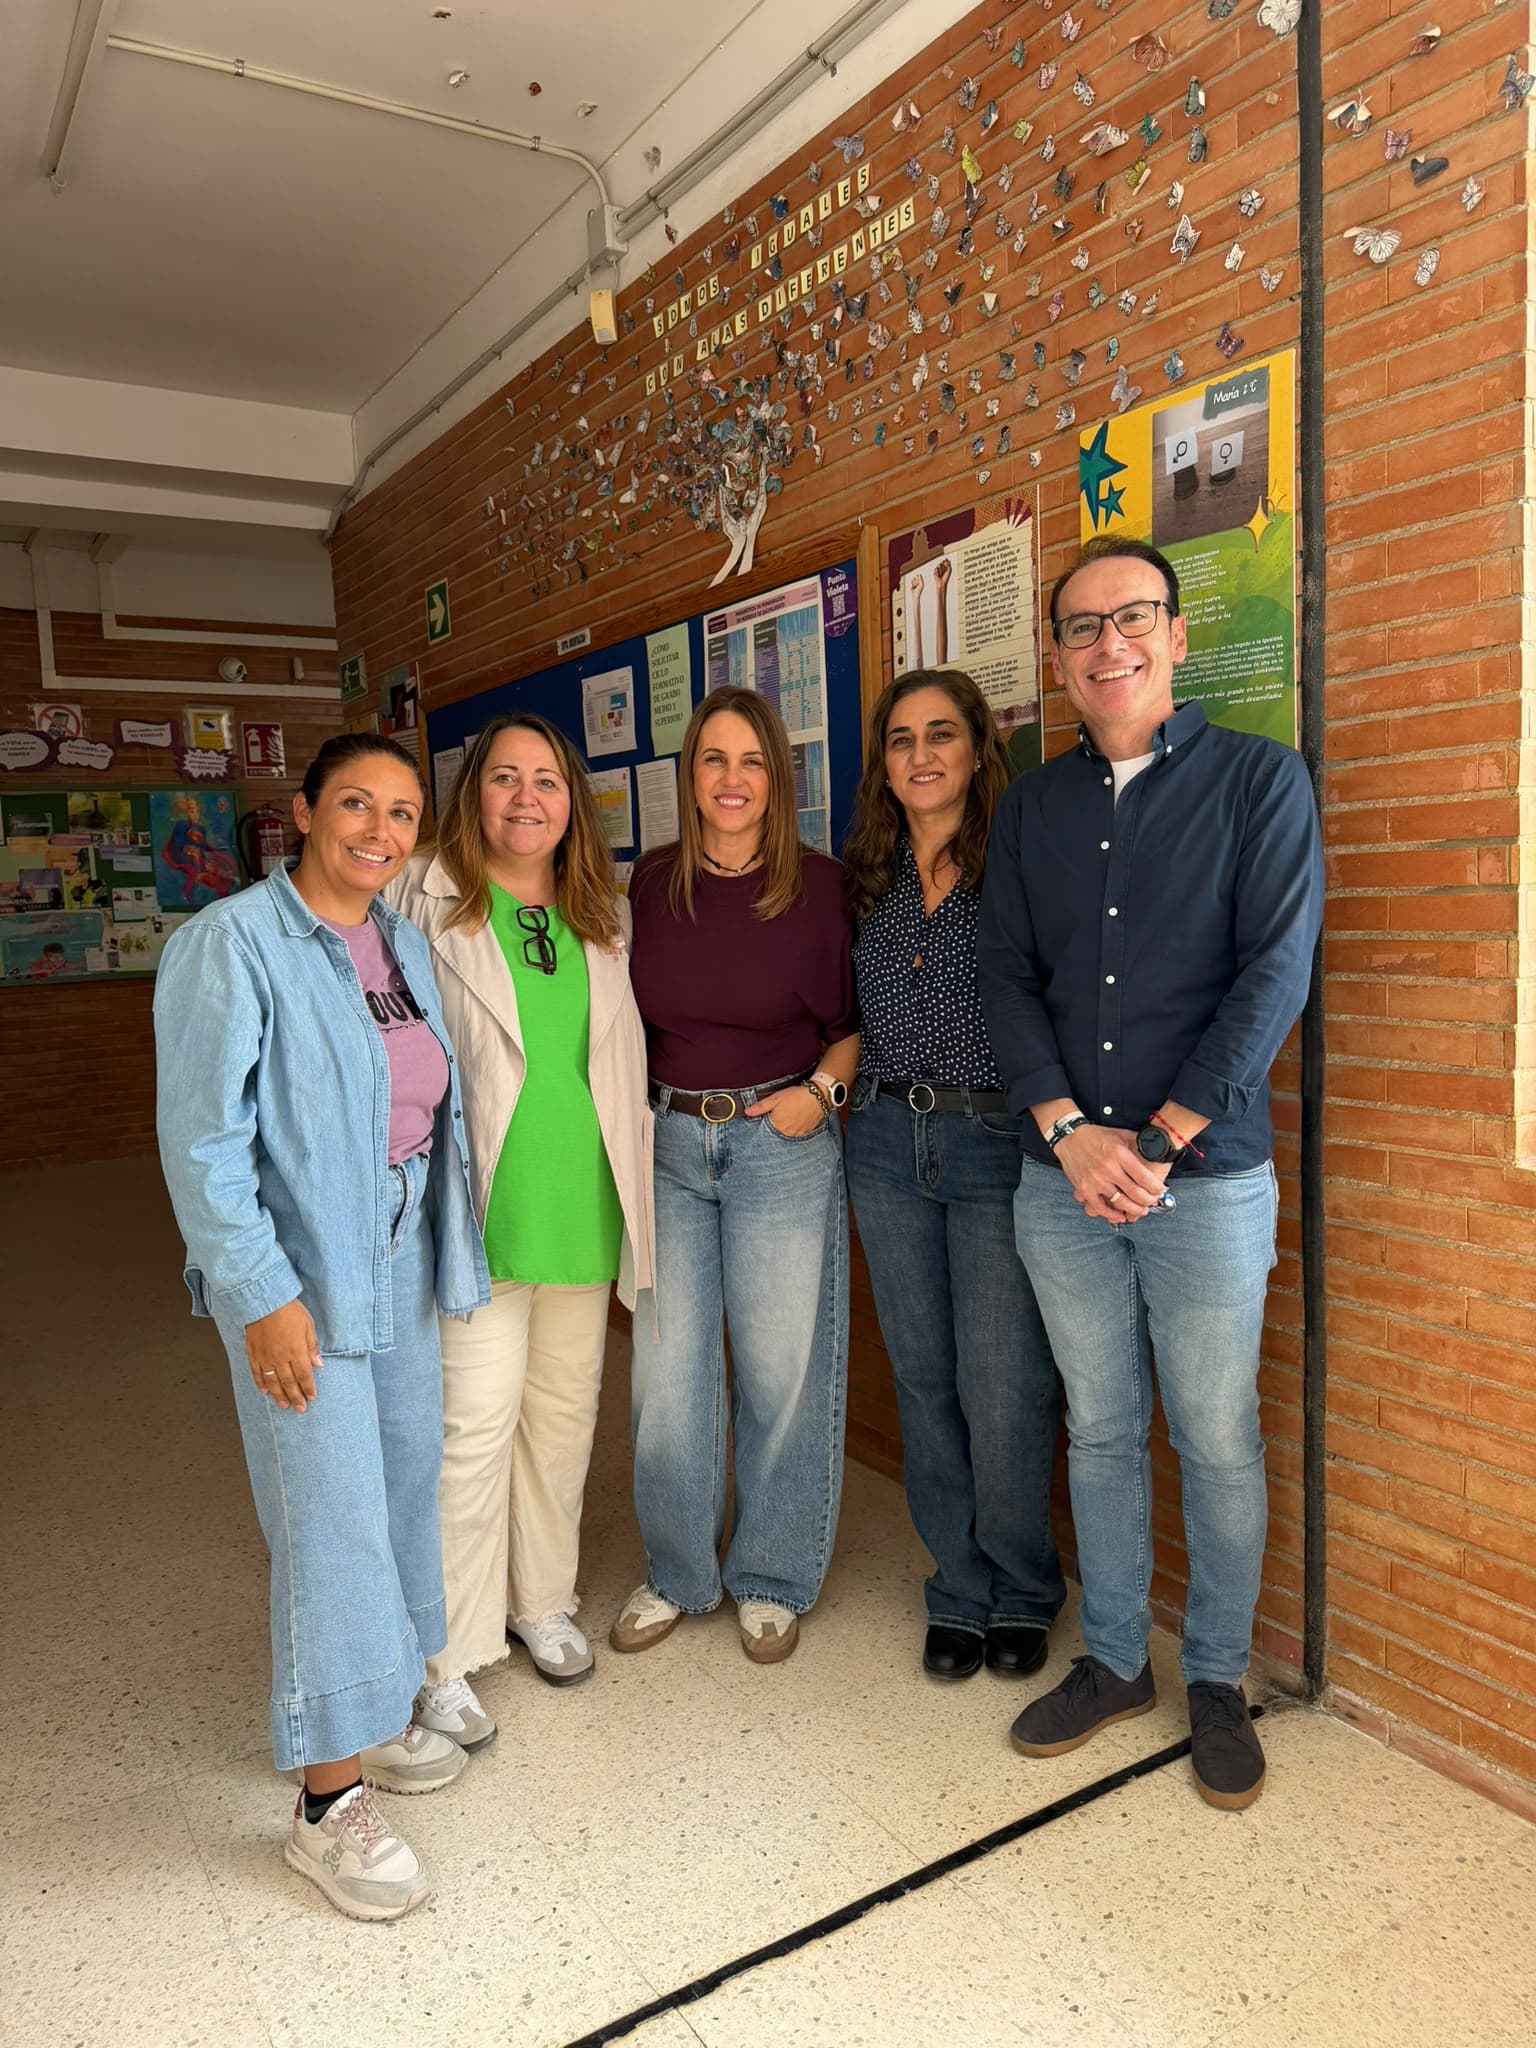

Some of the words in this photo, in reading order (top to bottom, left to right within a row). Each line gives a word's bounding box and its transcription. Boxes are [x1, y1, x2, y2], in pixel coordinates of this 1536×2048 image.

[755, 165, 868, 262] IGUALES
[648, 357, 682, 390] CON
[701, 315, 746, 354] ALAS
[761, 202, 912, 317] DIFERENTES
[1214, 386, 1239, 405] María
[827, 574, 846, 586] Punto
[827, 584, 848, 598] Violeta
